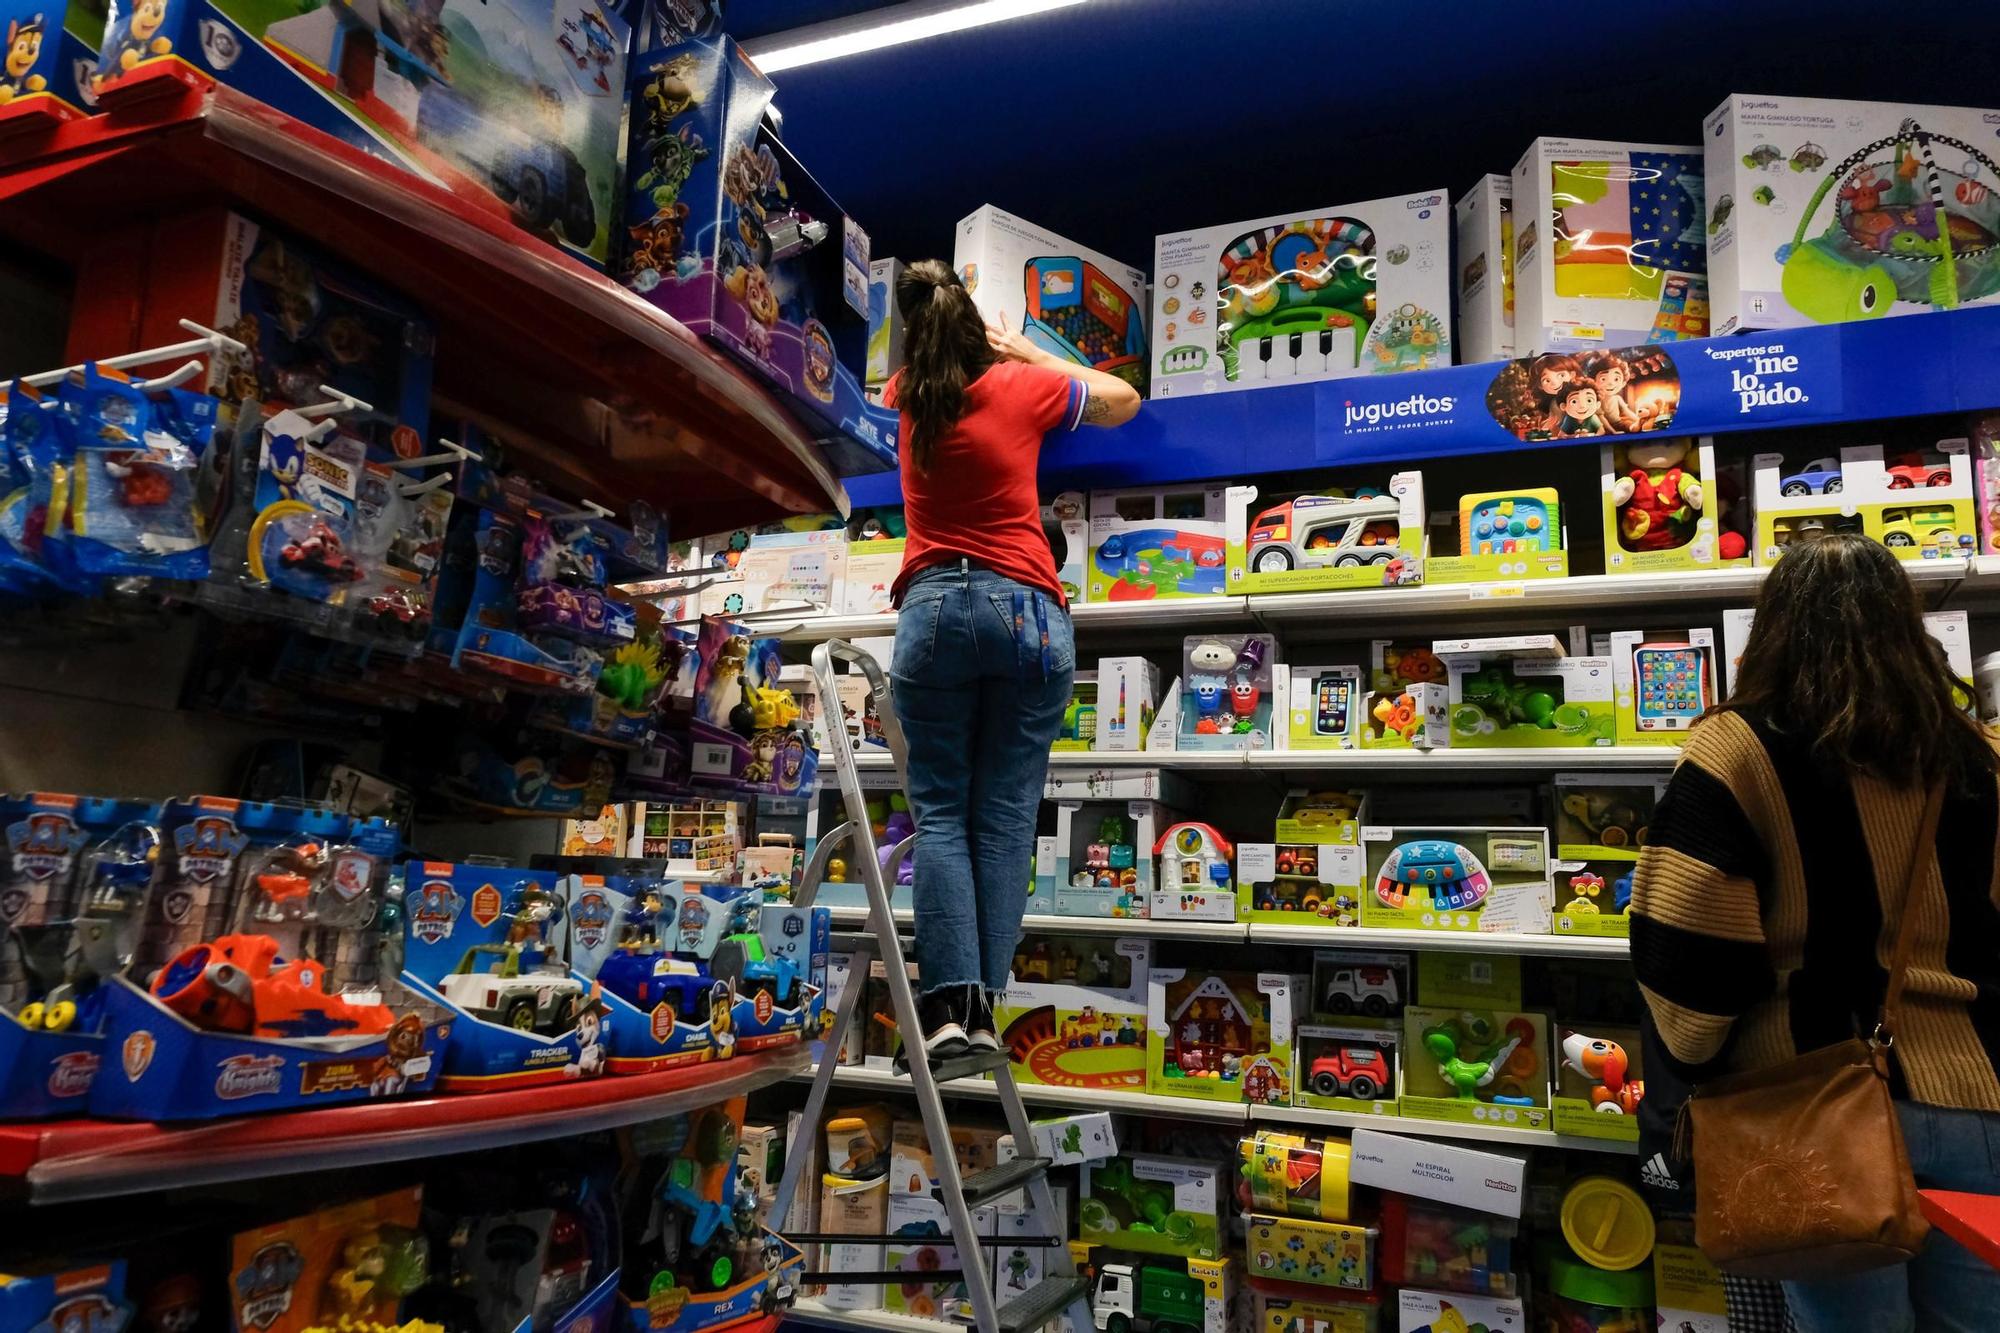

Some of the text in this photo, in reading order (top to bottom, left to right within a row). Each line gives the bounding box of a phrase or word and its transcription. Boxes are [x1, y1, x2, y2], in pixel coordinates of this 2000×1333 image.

[1741, 100, 1778, 109] juguettos
[1766, 115, 1801, 123] GIMNASIO
[1161, 237, 1192, 248] juguettos
[1711, 344, 1784, 361] expertos en
[1754, 355, 1799, 375] me
[1731, 369, 1759, 392] lo
[1344, 393, 1453, 427] juguettos
[306, 452, 349, 484] SONIC
[1310, 573, 1354, 582] PORTACOCHES
[184, 855, 228, 870] PATROL
[416, 922, 449, 935] PATROL
[578, 928, 604, 939] PATROL
[682, 930, 704, 940] PATROL
[685, 1032, 707, 1043] CHASE
[530, 1046, 569, 1060] TRACKER
[326, 1064, 355, 1077] ZUMA
[1355, 1151, 1384, 1164] juguettos
[1411, 1168, 1454, 1183] MULTICOLOR
[1425, 1163, 1451, 1175] ESPIRAL
[1485, 1178, 1517, 1193] Nenittos
[714, 1300, 734, 1315] REX
